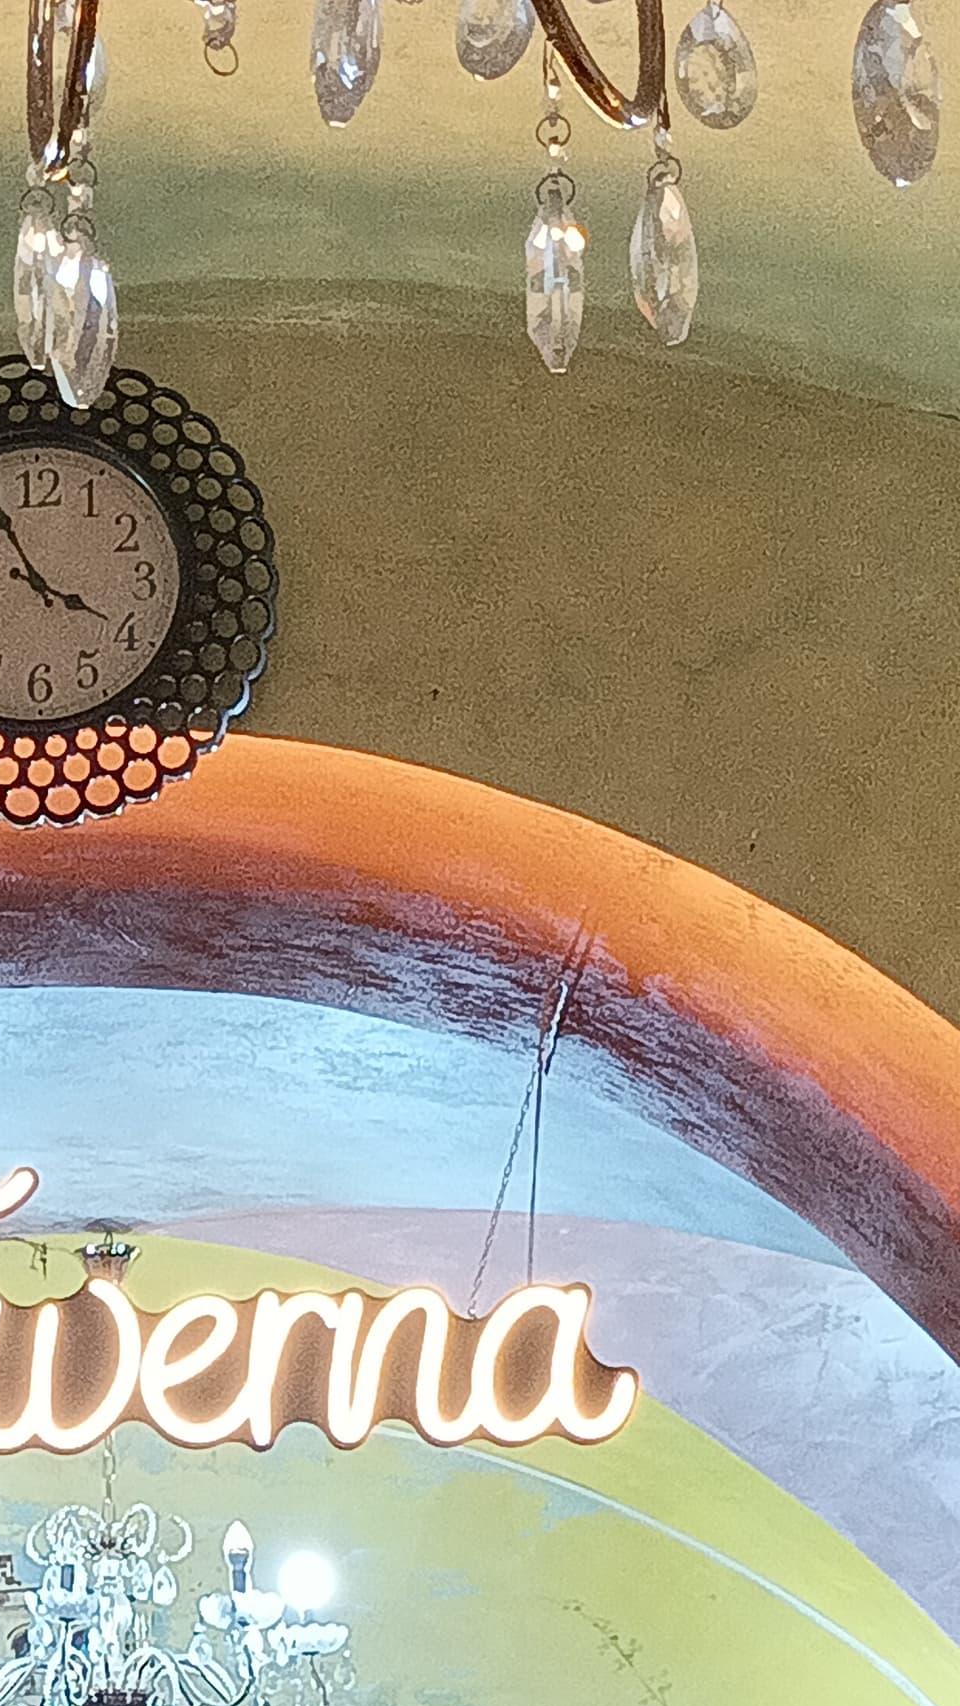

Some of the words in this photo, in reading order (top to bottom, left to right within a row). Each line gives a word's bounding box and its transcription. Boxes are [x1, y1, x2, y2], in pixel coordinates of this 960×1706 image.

[15, 468, 61, 508] 12
[80, 479, 100, 518] 1
[114, 514, 139, 553] 2
[134, 561, 157, 601] 3
[113, 612, 140, 651] 4
[28, 664, 53, 703] 6
[76, 650, 99, 689] 5
